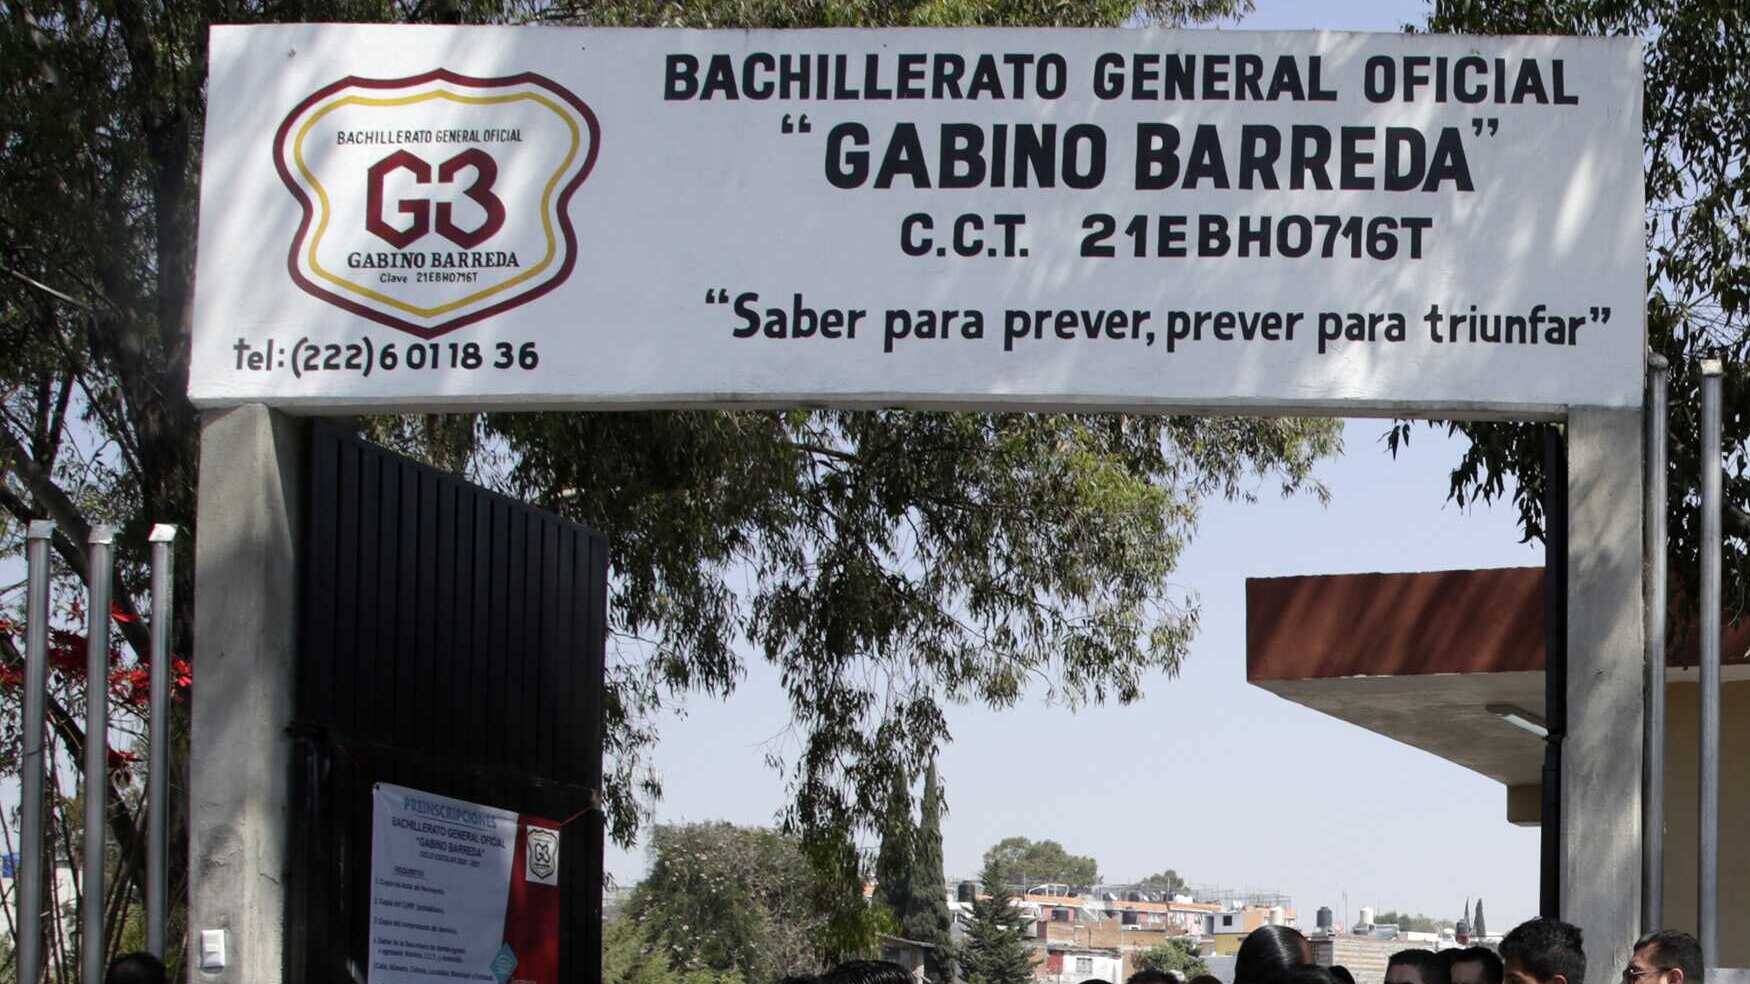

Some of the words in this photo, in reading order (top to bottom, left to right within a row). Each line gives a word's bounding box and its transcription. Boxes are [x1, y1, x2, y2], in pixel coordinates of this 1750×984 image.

[664, 52, 1068, 101] BACHILLERATO
[1094, 52, 1338, 102] GENERAL
[1364, 54, 1579, 106] OFICIAL
[337, 130, 432, 146] BACHILLERATO
[435, 129, 481, 144] GENERAL
[483, 128, 522, 143] OFICIAL
[781, 113, 1107, 190] “GABINO
[1134, 117, 1499, 192] BARREDA”
[365, 147, 506, 250] G3
[900, 212, 1029, 258] C.C.T.
[347, 251, 426, 269] GABINO
[430, 251, 520, 269] BARREDA
[379, 272, 408, 284] Clave
[705, 288, 866, 340] “Saber
[883, 308, 984, 353] para
[1003, 308, 1156, 352] prever,
[1166, 310, 1304, 353] prever
[1317, 311, 1407, 355] para
[1424, 303, 1611, 346] triunfar”
[493, 341, 539, 370] 36
